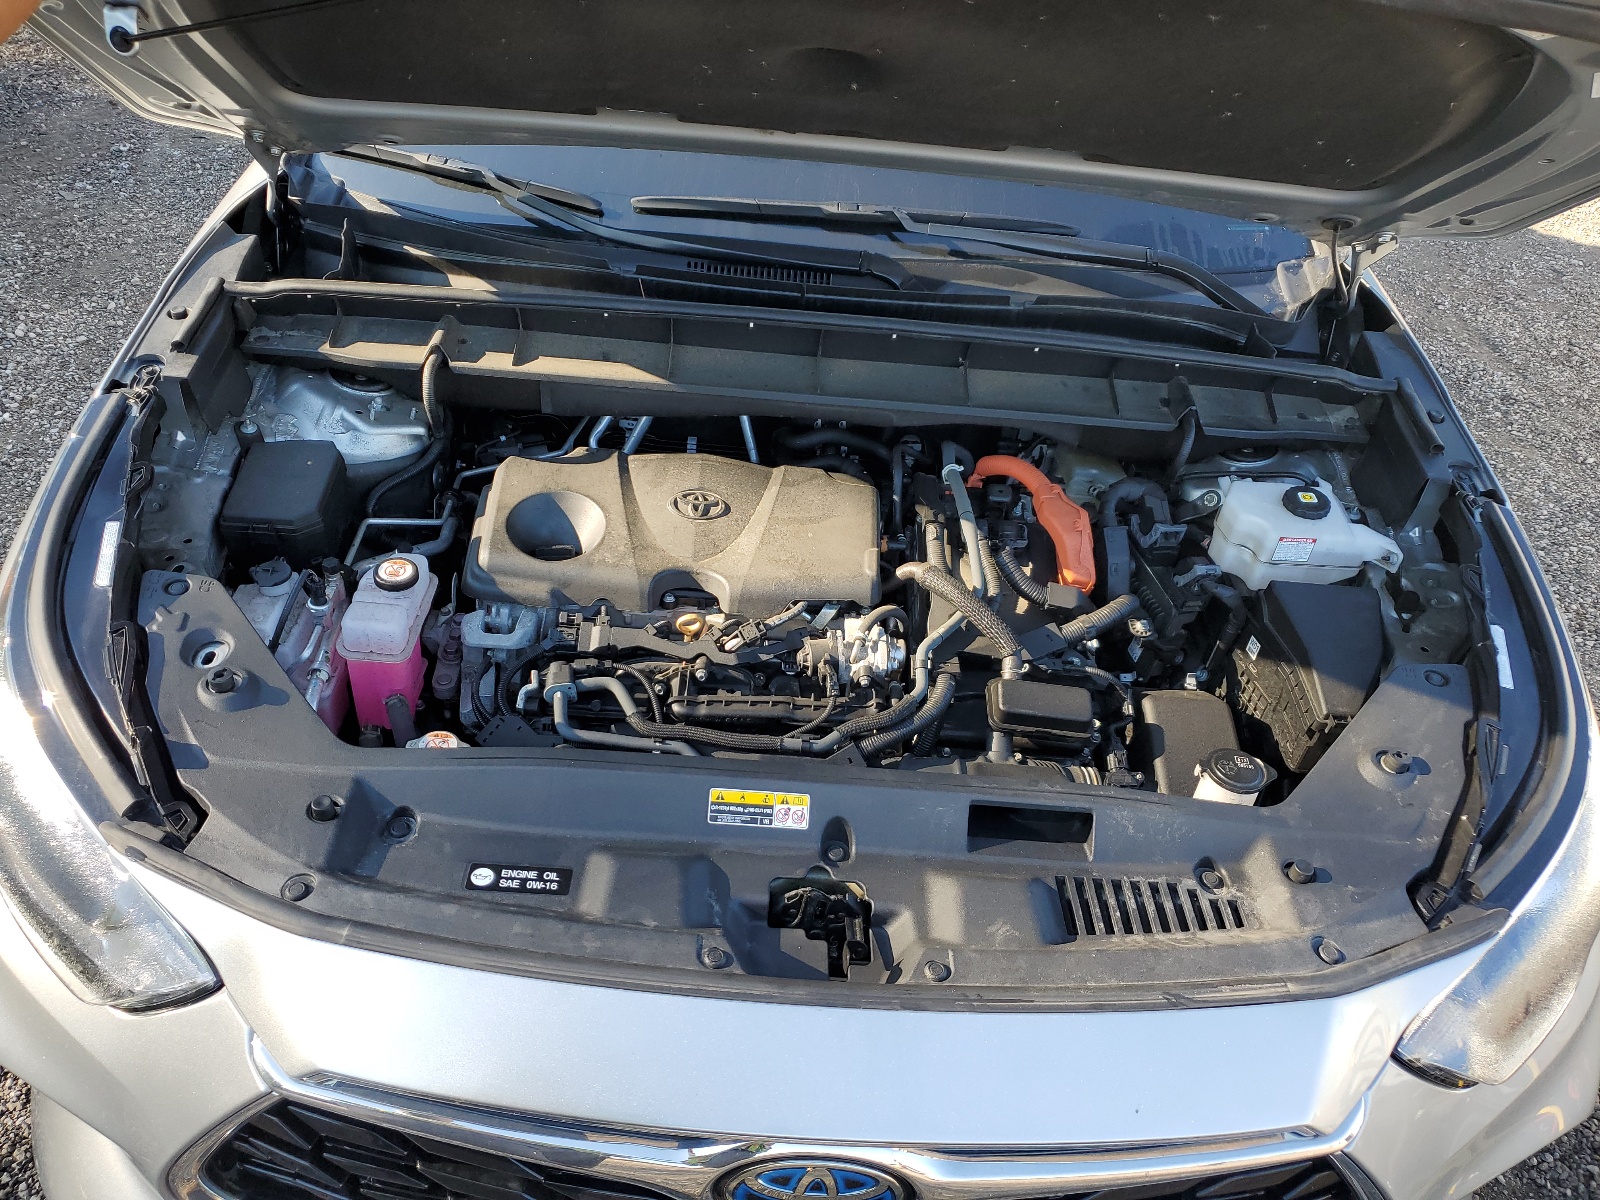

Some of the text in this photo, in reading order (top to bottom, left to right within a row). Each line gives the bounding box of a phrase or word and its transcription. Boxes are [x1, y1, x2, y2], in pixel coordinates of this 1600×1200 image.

[501, 869, 560, 880] ENGINE OIL
[499, 879, 558, 890] SAE 0W-16
